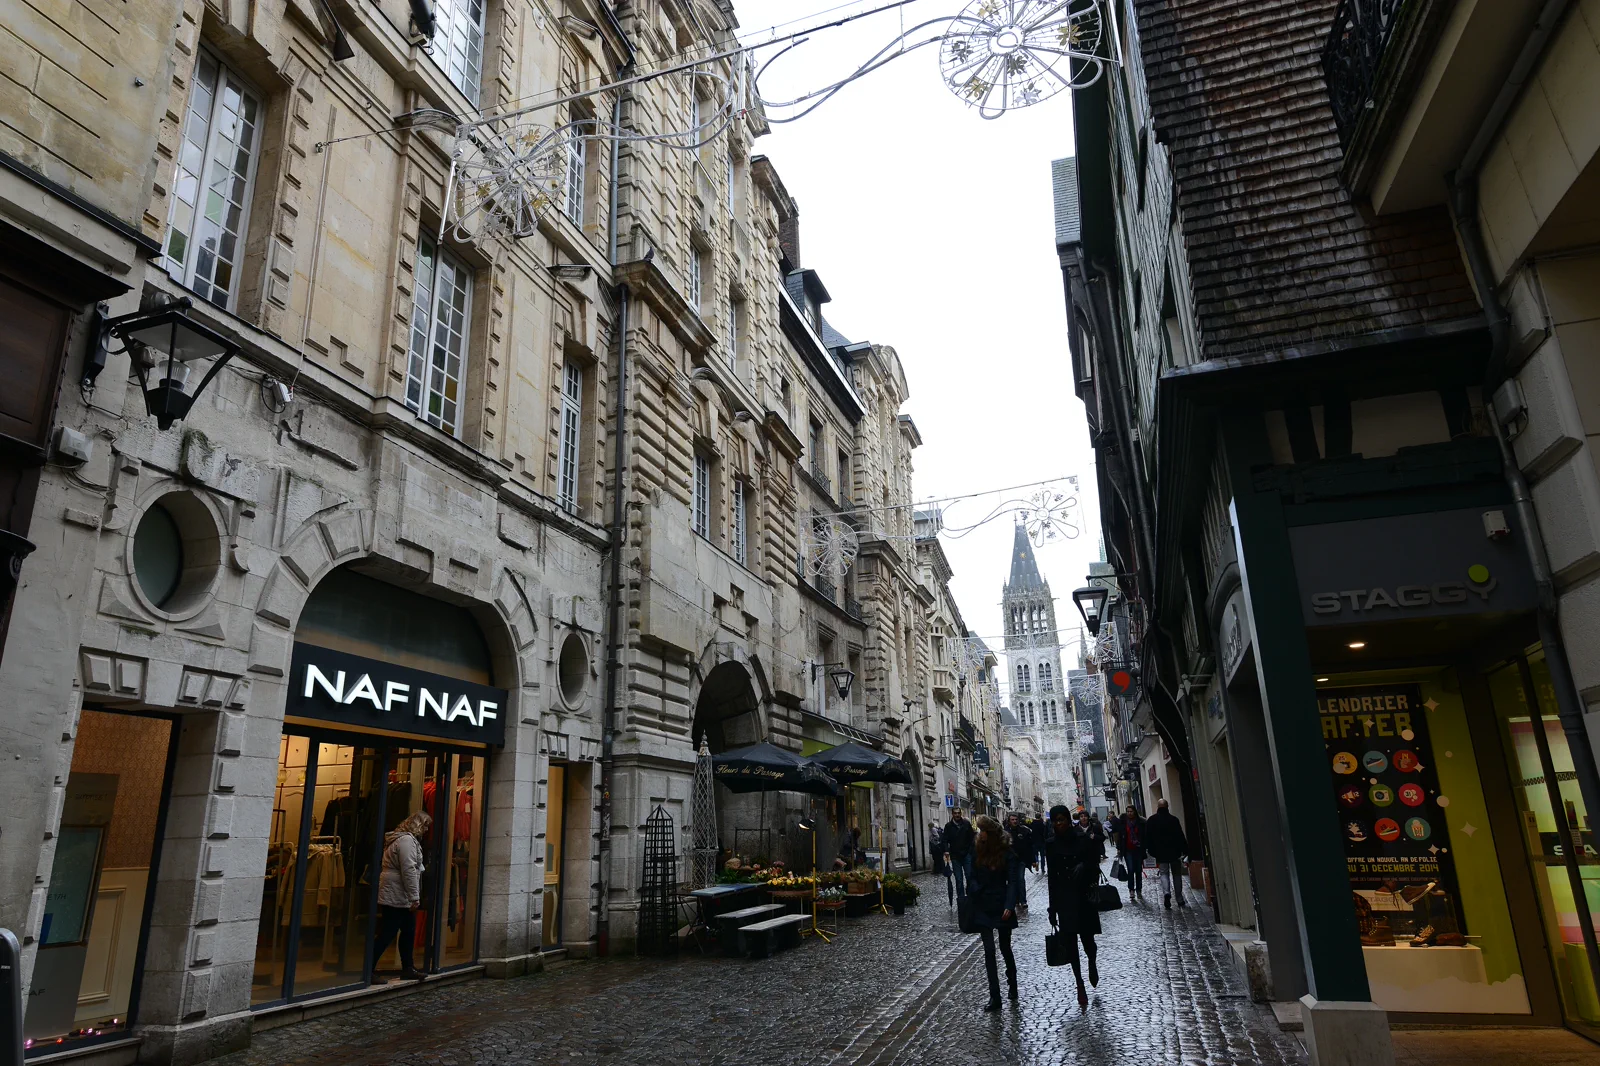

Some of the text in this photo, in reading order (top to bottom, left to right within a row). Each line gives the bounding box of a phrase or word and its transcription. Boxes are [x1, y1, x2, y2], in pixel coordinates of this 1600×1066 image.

[1311, 572, 1497, 615] STAGGY
[303, 664, 498, 727] NAF NAF
[1317, 694, 1409, 714] LENDRIER
[1320, 712, 1413, 739] AFTER
[715, 764, 785, 779] Fleurs du Passage
[832, 765, 841, 773] du
[843, 764, 869, 776] Passage
[1360, 864, 1369, 872] 31
[1371, 864, 1416, 872] DECEMBRE
[1418, 863, 1440, 872] 2014
